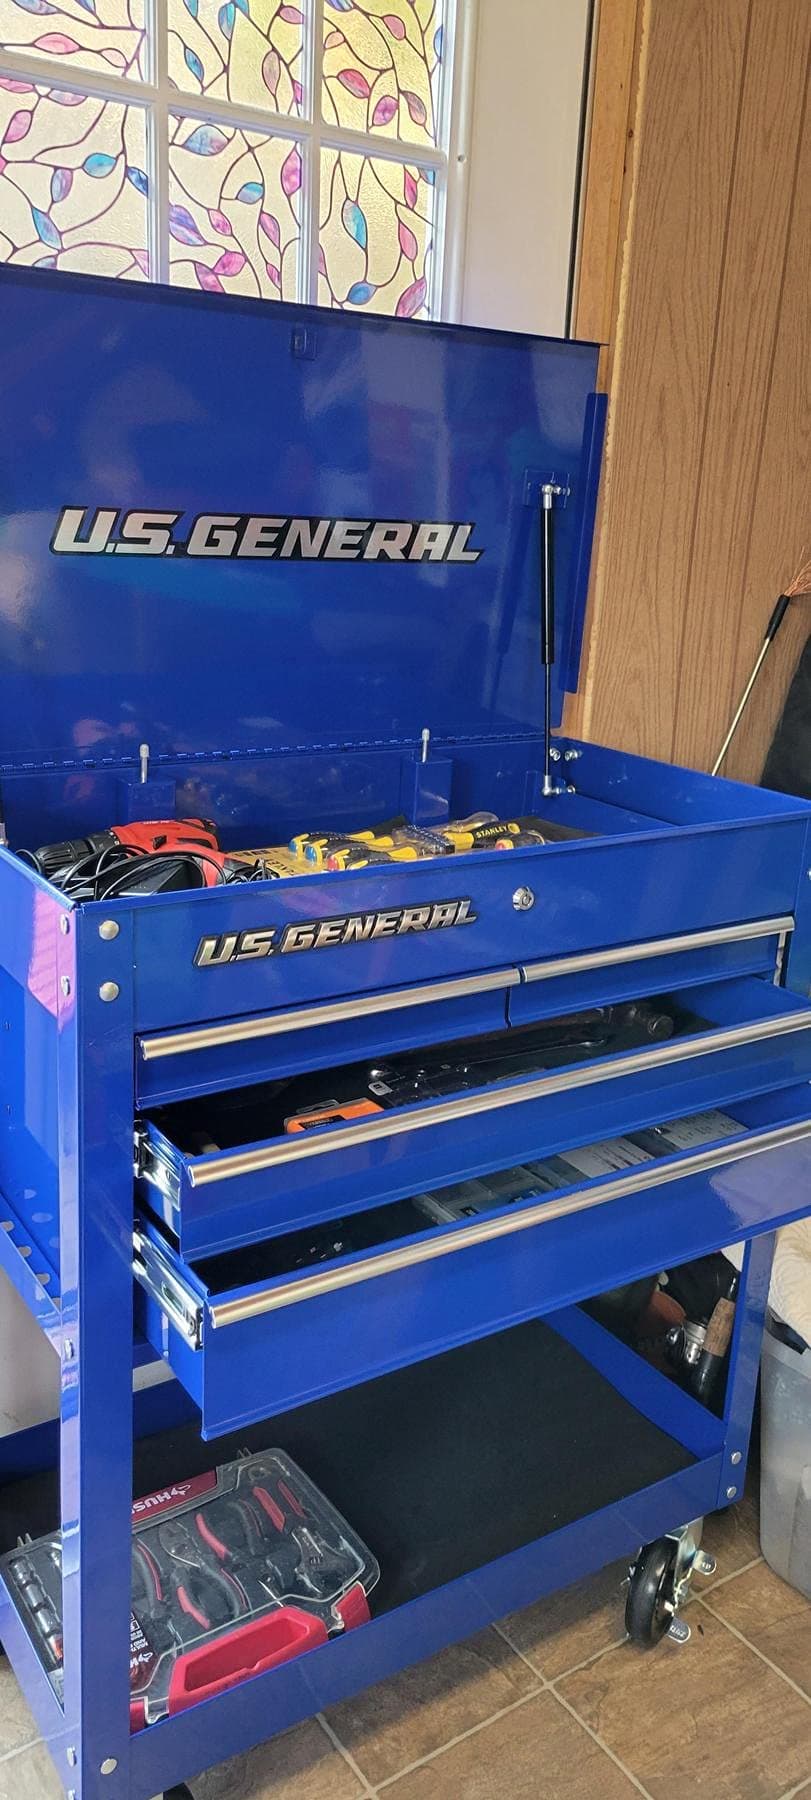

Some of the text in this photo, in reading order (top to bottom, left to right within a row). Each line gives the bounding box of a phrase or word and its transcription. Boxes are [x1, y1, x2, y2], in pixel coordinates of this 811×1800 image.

[53, 508, 482, 561] U.S. GENERAL
[475, 824, 508, 839] STANLEY
[197, 900, 477, 967] U.S. GENERAL
[131, 1491, 172, 1514] HUS
